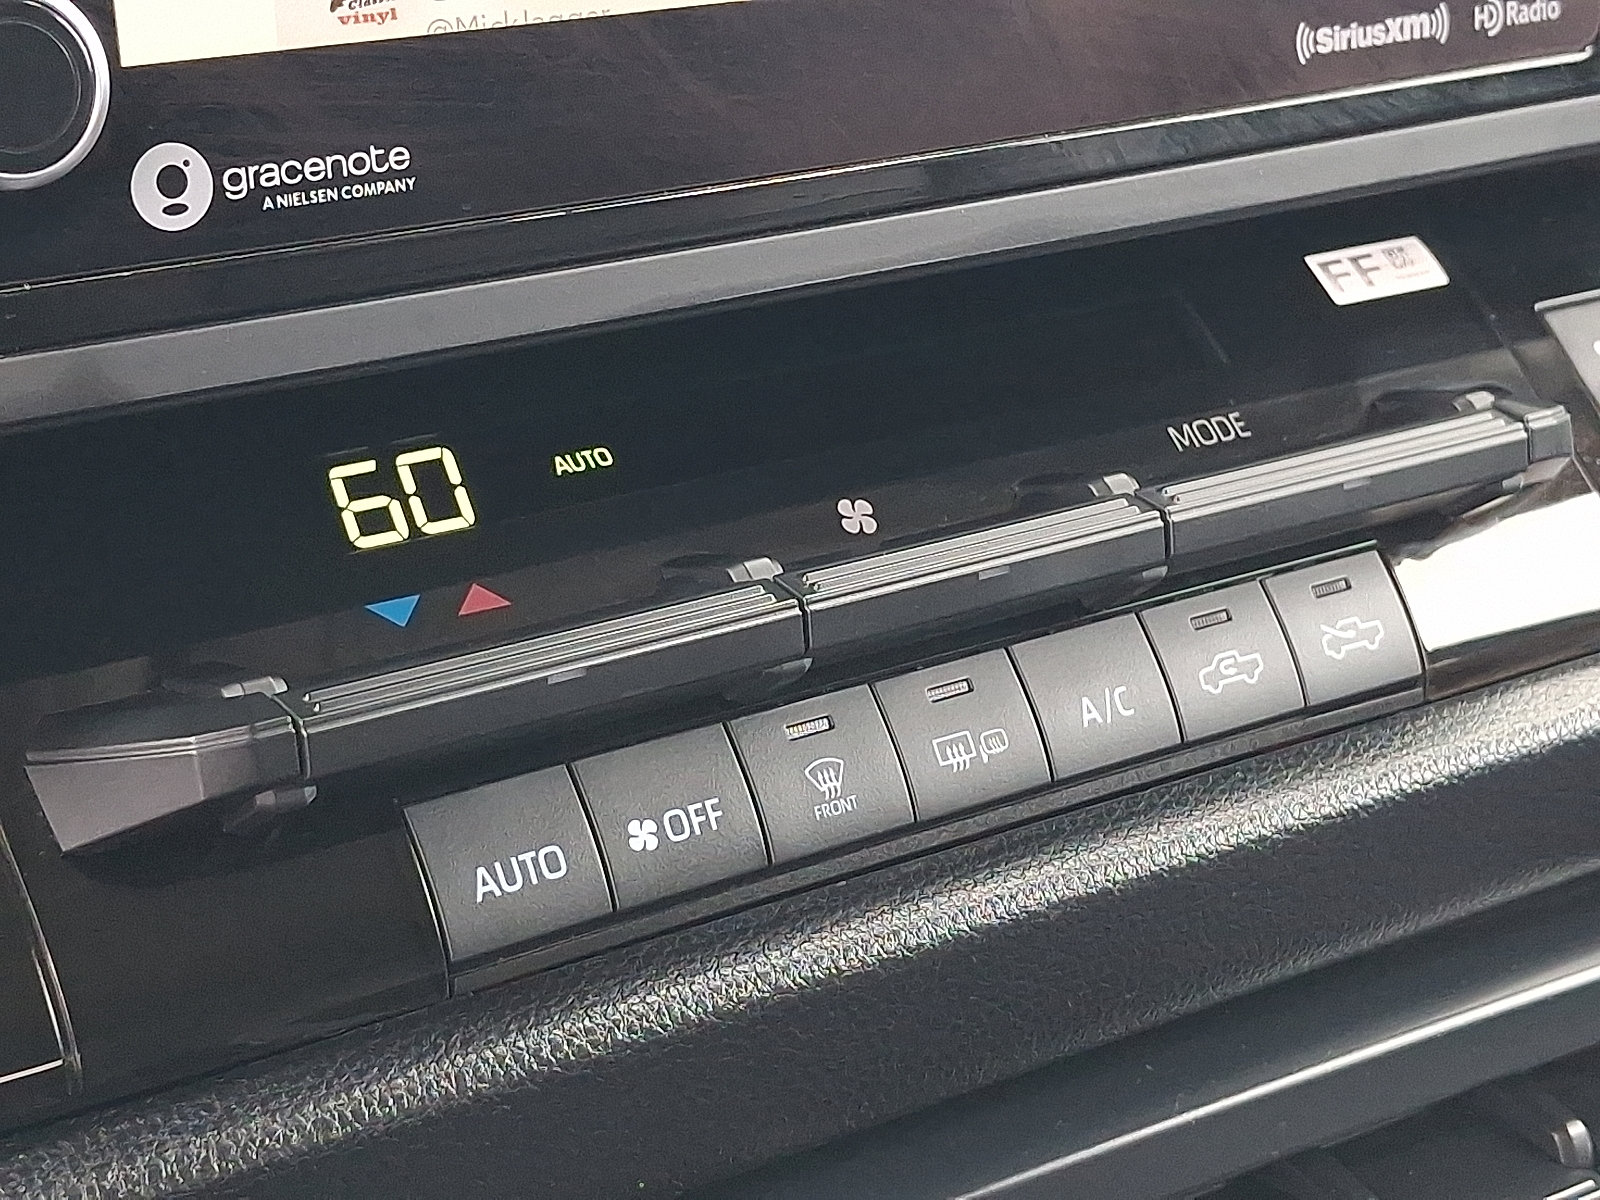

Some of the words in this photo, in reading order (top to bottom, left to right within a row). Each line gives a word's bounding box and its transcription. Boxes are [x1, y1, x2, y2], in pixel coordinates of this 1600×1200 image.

[337, 8, 398, 25] vinyl
[1506, 0, 1561, 26] Radio
[222, 145, 411, 200] gracenote
[262, 196, 275, 211] A
[277, 186, 339, 209] NIELSEN
[341, 177, 417, 199] COMPANY
[1317, 253, 1381, 293] FF
[1167, 411, 1252, 453] MODE
[554, 447, 614, 477] AUTO
[328, 446, 476, 550] 60
[1081, 686, 1135, 727] A/C
[663, 798, 724, 843] OFF
[814, 795, 858, 820] FRONT
[474, 844, 568, 904] AUTO
